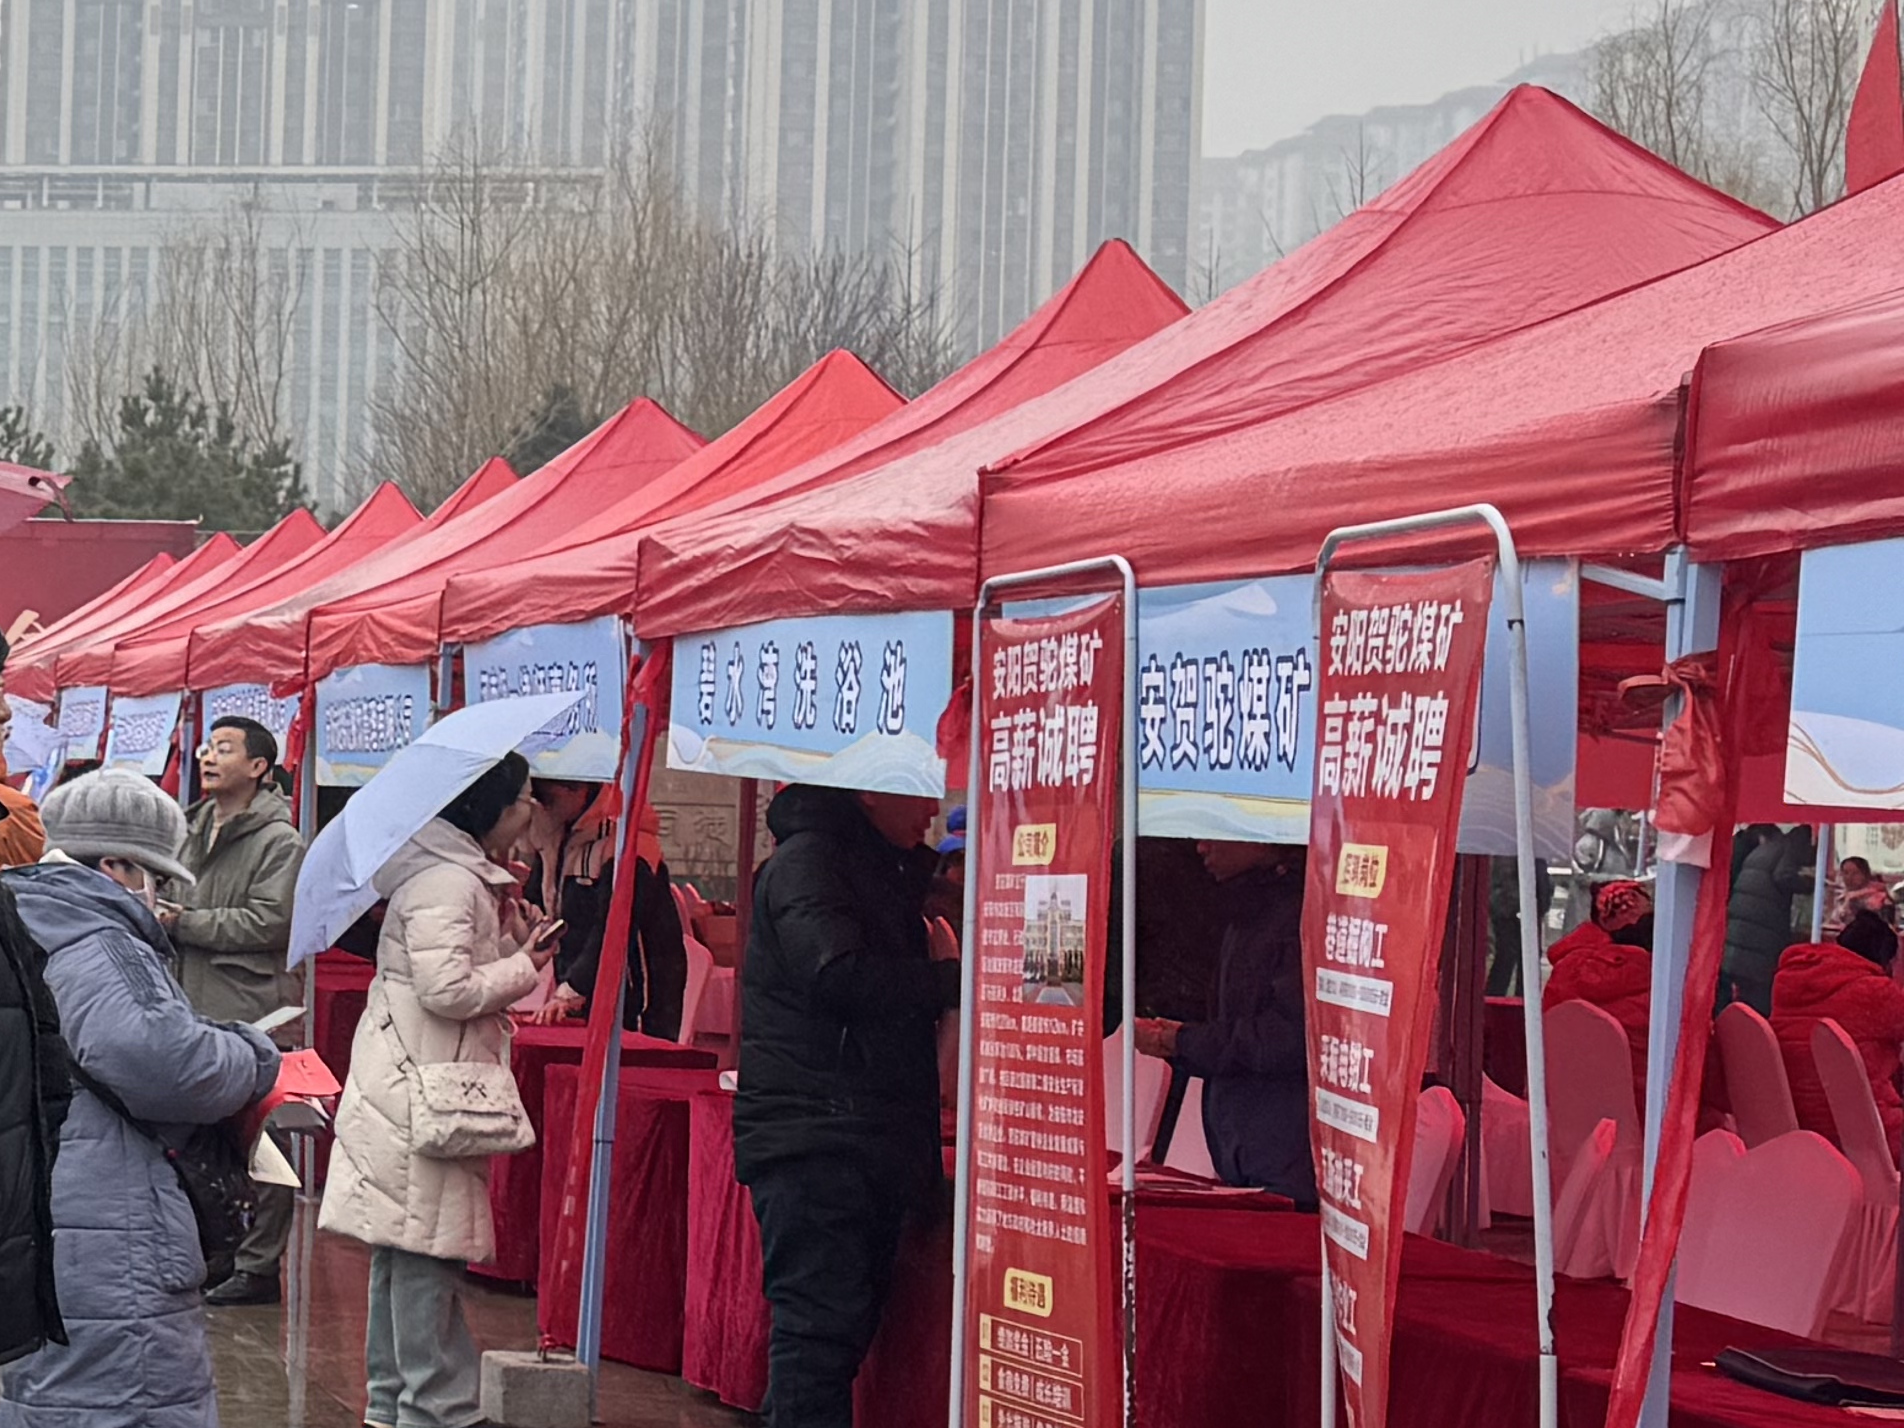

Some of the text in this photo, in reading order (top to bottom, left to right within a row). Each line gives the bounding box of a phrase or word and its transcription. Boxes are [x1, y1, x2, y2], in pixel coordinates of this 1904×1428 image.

[993, 628, 1103, 700] 安阳贺驼煤矿
[1328, 599, 1464, 676] 安阳贺驼煤矿
[699, 640, 906, 735] 碧水湾洗浴池
[989, 699, 1099, 793] 高薪诚聘
[1319, 691, 1449, 801] 高薪诚聘
